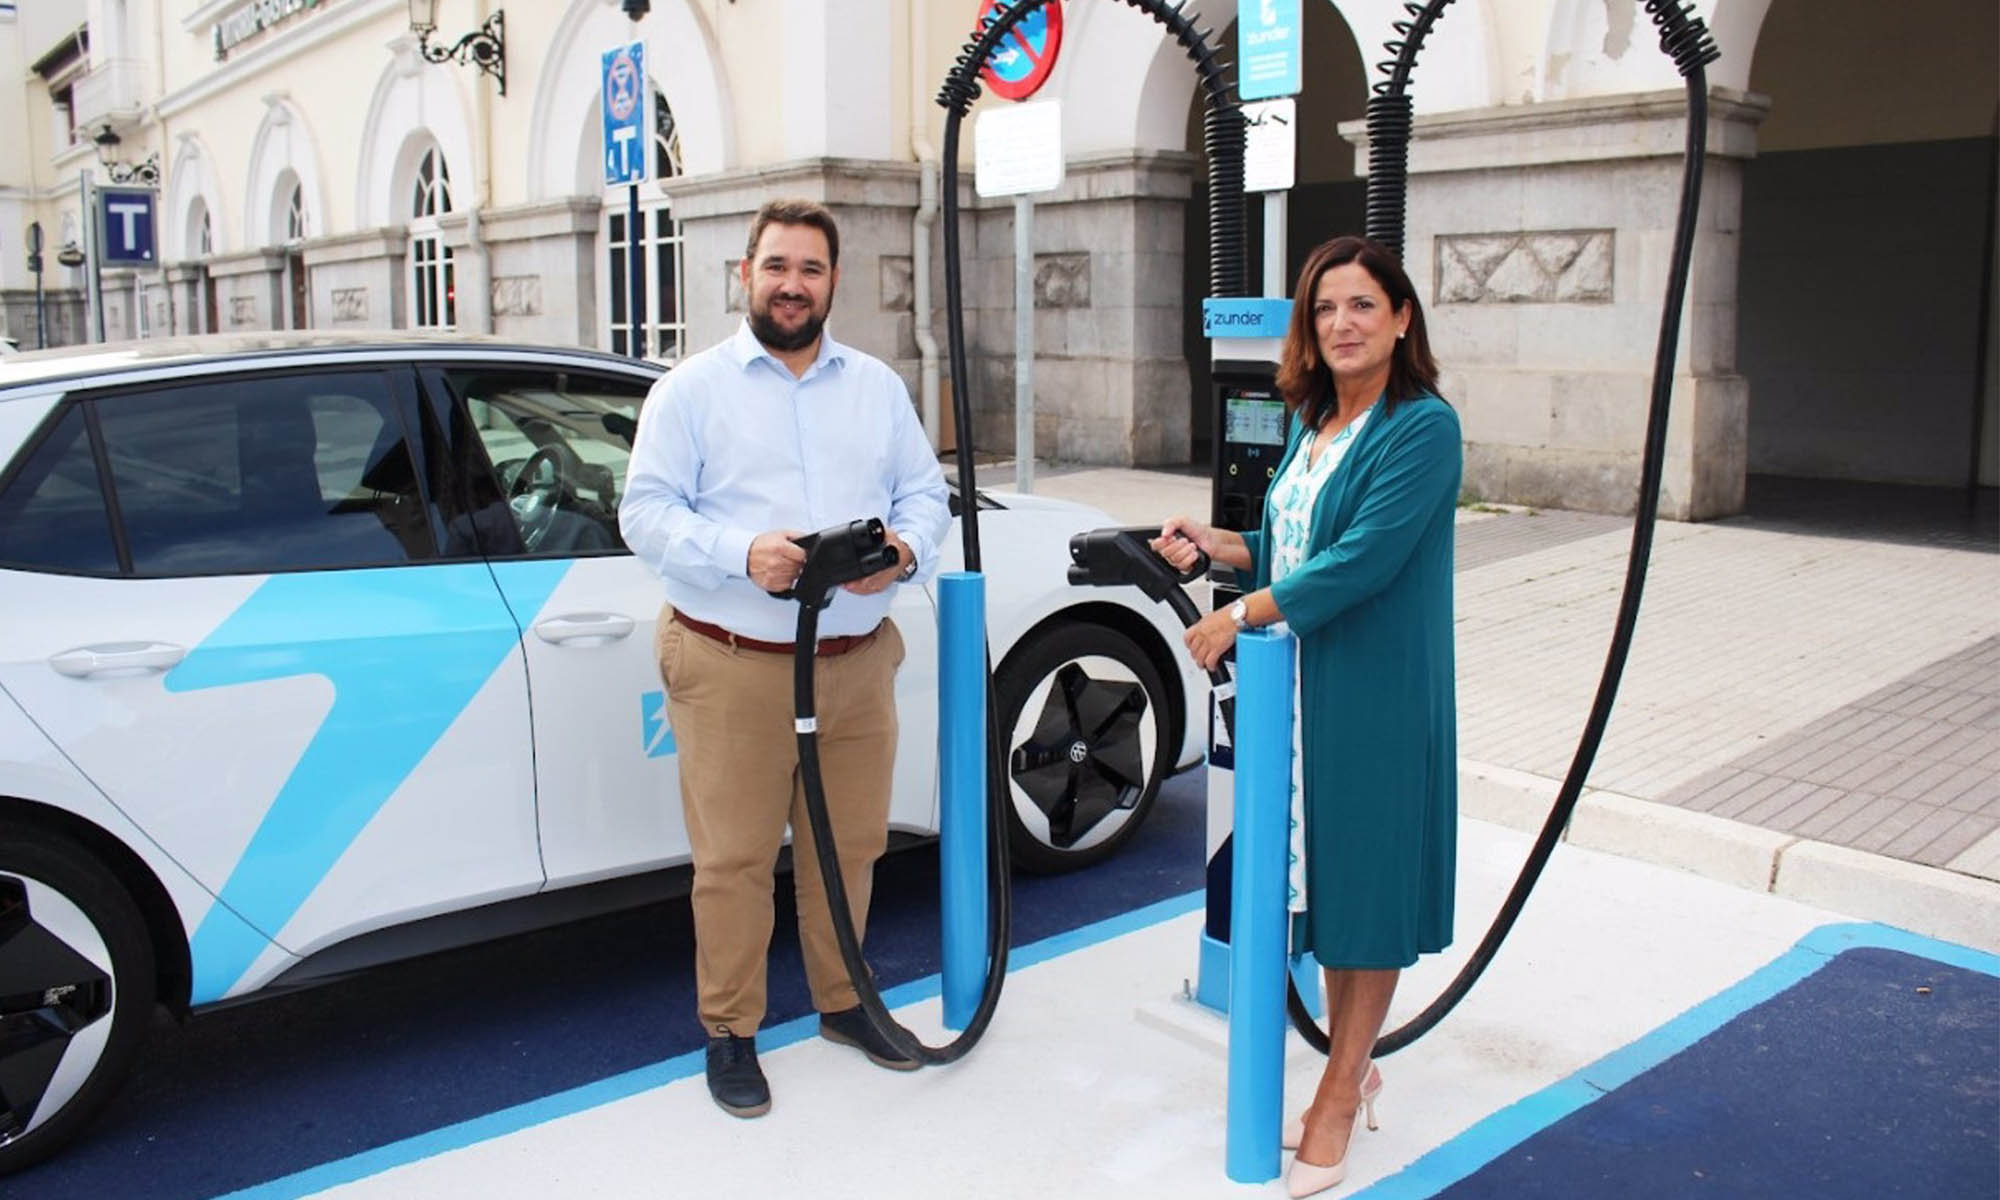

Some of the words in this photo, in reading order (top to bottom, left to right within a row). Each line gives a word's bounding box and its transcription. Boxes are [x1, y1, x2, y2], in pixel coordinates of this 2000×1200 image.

[612, 125, 637, 176] T
[108, 203, 148, 251] T
[1214, 310, 1264, 326] zunder
